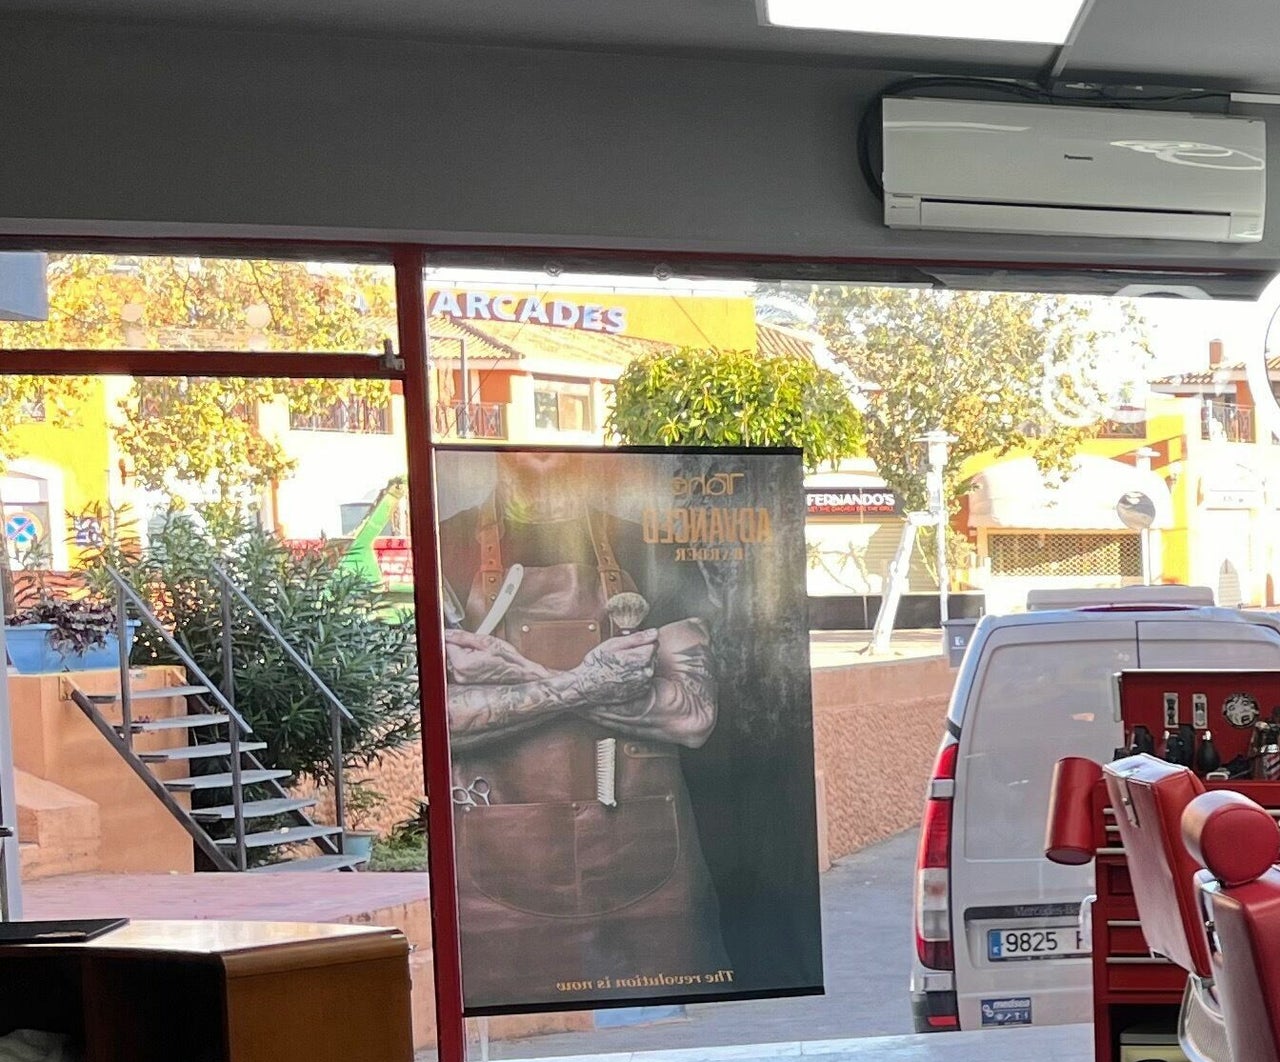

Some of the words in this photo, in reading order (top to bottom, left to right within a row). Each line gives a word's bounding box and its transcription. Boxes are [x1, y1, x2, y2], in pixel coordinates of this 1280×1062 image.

[431, 290, 627, 333] ARCADES
[806, 493, 896, 506] FERNANDO'S
[1005, 932, 1058, 952] 9825
